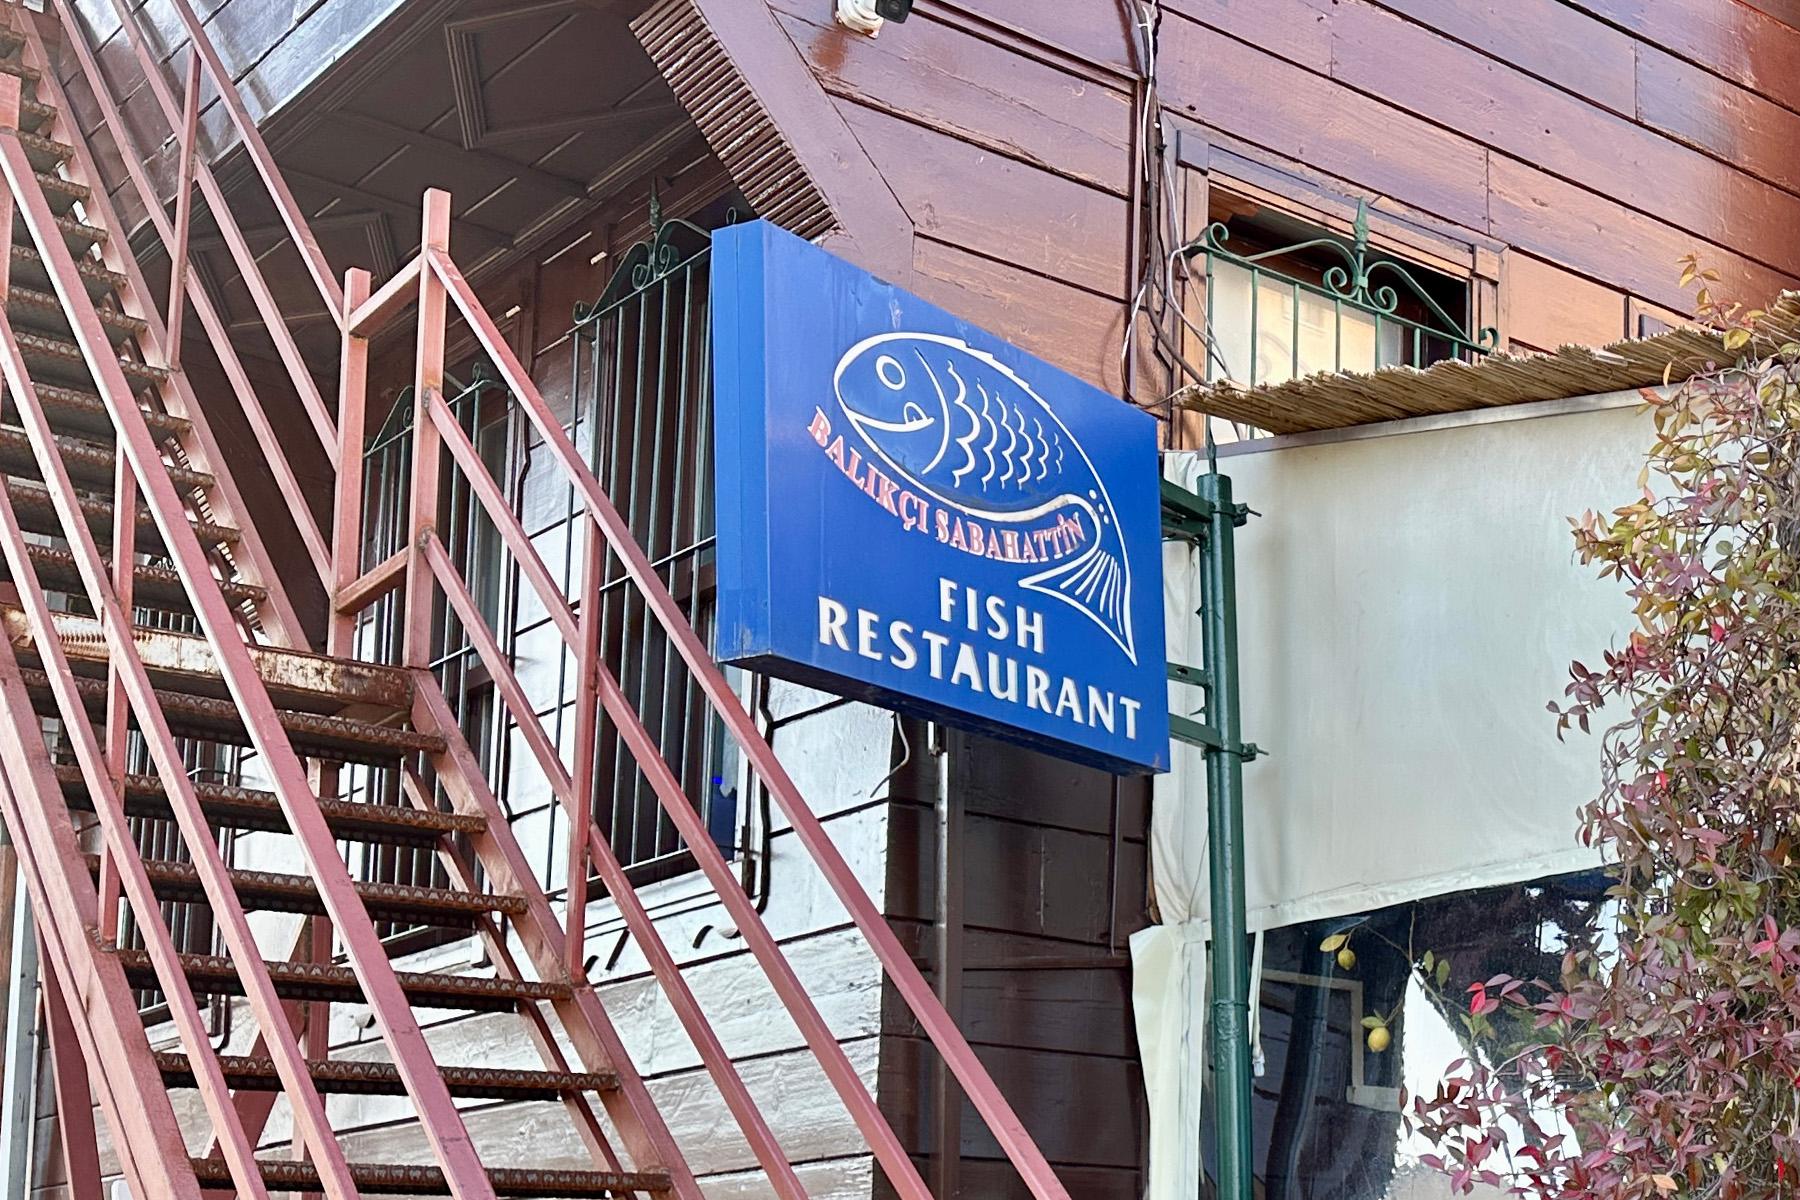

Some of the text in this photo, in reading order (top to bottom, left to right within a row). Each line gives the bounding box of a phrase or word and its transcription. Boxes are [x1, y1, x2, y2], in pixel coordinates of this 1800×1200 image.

[807, 405, 1086, 564] BALIKÇI SABAHATTİN
[818, 595, 1141, 740] RESTAURANT
[939, 577, 1044, 655] FISH
